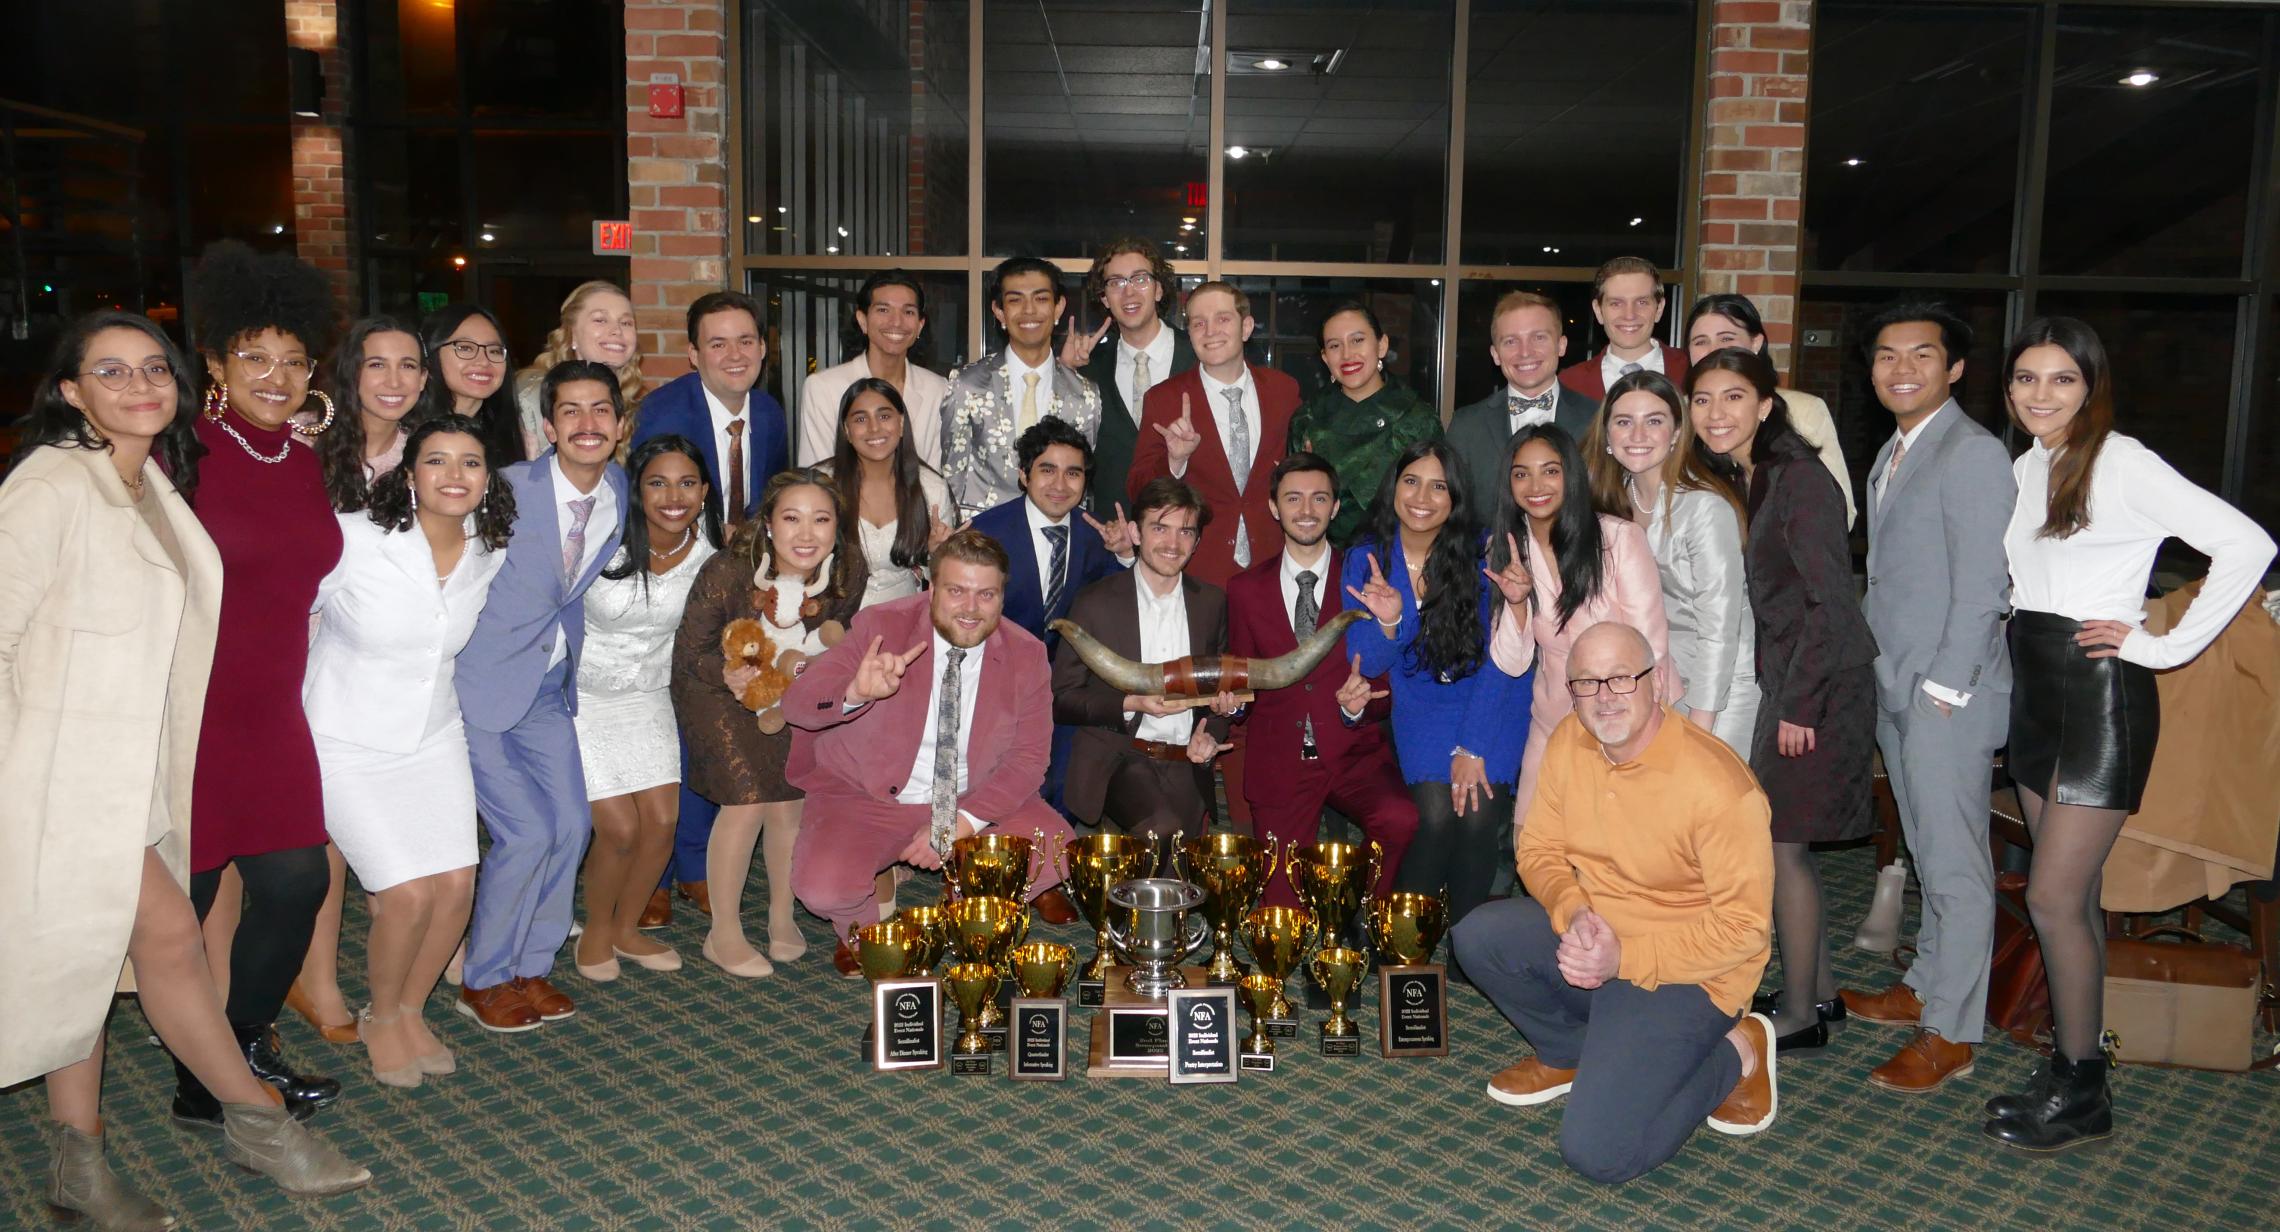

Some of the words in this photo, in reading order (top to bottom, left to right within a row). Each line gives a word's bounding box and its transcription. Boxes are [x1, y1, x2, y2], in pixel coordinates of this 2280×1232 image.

[1406, 988, 1422, 998] NFA
[900, 1002, 916, 1010] NFA
[1194, 1012, 1212, 1020] NFA
